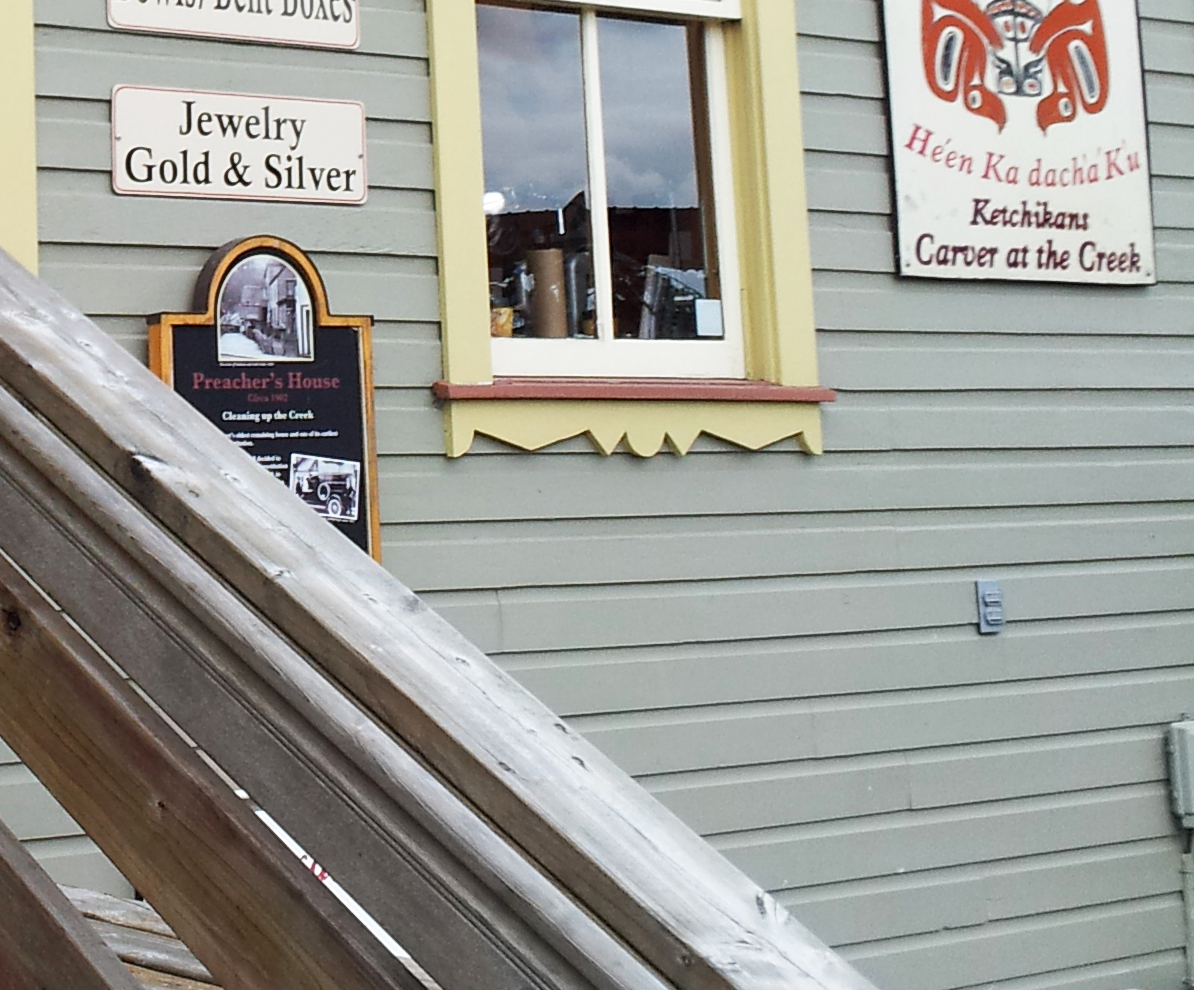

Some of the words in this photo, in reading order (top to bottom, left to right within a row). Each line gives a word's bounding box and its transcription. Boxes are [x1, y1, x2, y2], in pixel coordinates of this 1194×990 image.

[179, 100, 306, 150] Jewelry
[125, 146, 212, 185] Gold
[223, 151, 252, 187] &
[264, 154, 357, 192] Silver
[981, 151, 1019, 185] Ka
[970, 198, 1089, 230] Ketchikans
[916, 233, 998, 268] Carver
[1006, 245, 1029, 269] at
[1037, 240, 1070, 270] the
[1079, 241, 1142, 273] Creek
[192, 372, 283, 389] Preacher's
[287, 372, 340, 389] House
[222, 411, 260, 423] Cleaning
[262, 414, 273, 423] up
[274, 410, 287, 420] the
